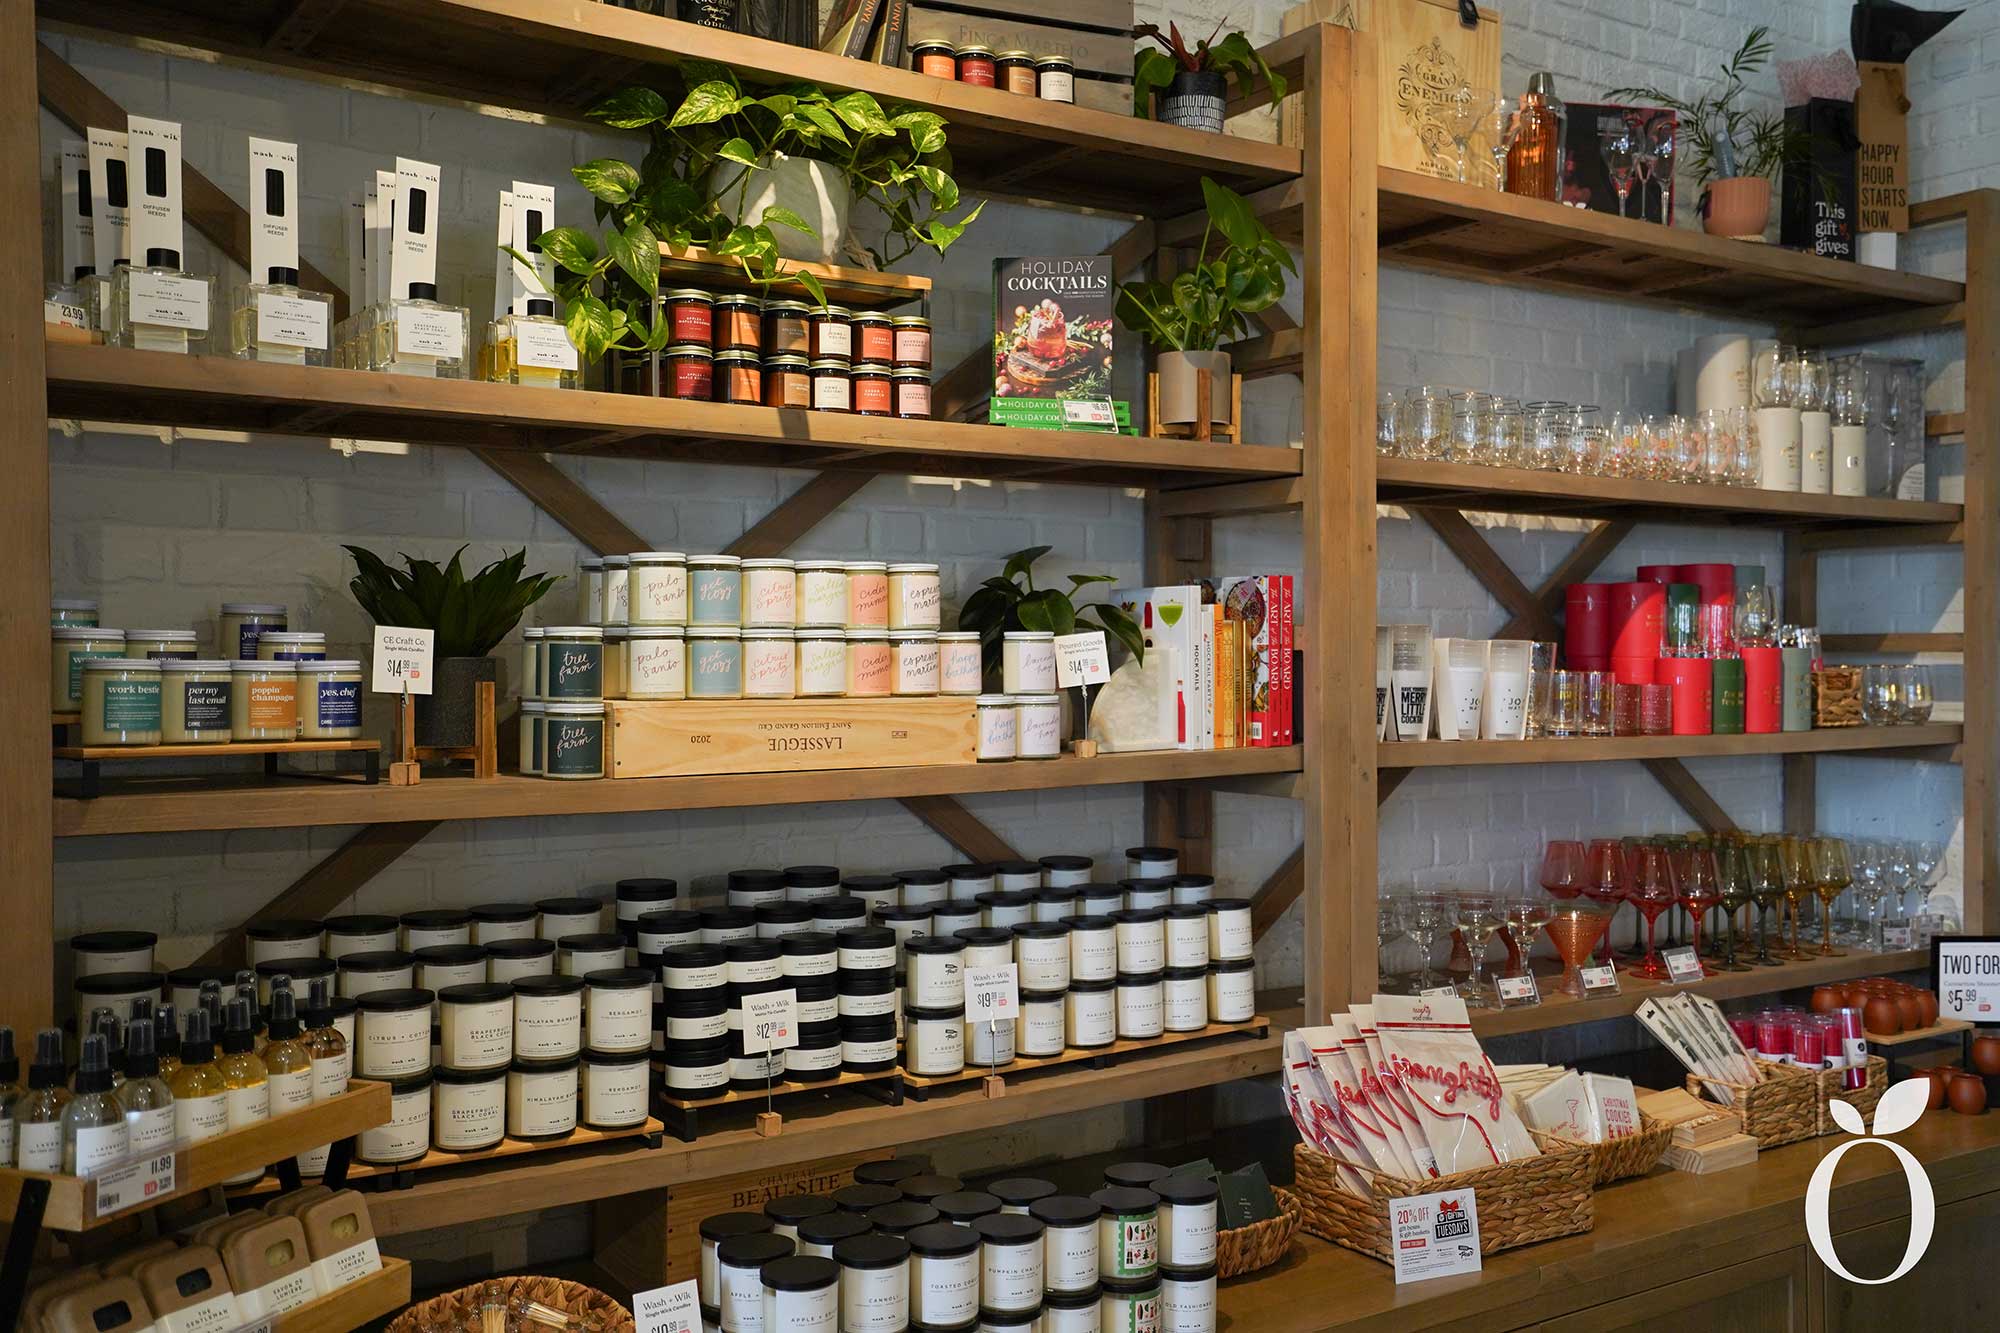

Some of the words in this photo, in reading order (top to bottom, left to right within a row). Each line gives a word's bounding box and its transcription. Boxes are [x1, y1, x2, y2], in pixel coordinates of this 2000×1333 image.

[1422, 71, 1451, 86] GRAN
[1861, 143, 1900, 163] HAPPY
[1861, 165, 1894, 185] HOUR
[1861, 187, 1907, 207] STARTS
[1815, 201, 1846, 219] This
[1815, 219, 1838, 238] gift
[1862, 210, 1893, 229] NOW.
[1815, 237, 1849, 255] gives
[1021, 261, 1095, 275] HOLIDAY
[1007, 274, 1107, 294] COCKTAILS
[1008, 400, 1044, 408] HOLIDAY
[1007, 413, 1043, 421] HOLIDAY
[1270, 601, 1279, 624] ART
[1283, 601, 1291, 624] ART
[383, 636, 394, 644] CE
[395, 636, 414, 645] Craft
[1058, 641, 1082, 650] Poured
[1082, 639, 1104, 647] Goods
[562, 650, 588, 667] tree
[558, 662, 596, 685] farm
[1271, 648, 1279, 691] BOARD
[1283, 648, 1292, 690] BOARD
[108, 685, 136, 694] work
[188, 688, 204, 697] per
[205, 688, 219, 697] my
[188, 695, 205, 705] last
[206, 695, 227, 704] email
[560, 724, 586, 742] tree
[757, 722, 774, 731] CRU
[775, 722, 800, 731] GRAND
[835, 721, 852, 730] SAINT
[556, 735, 595, 758] farm
[690, 735, 712, 744] 2020
[1942, 955, 1972, 975] TWO
[1975, 955, 2000, 975] FOR
[751, 1003, 770, 1012] Wash
[775, 999, 790, 1007] Wik
[1605, 1109, 1632, 1125] COOKIES
[151, 1155, 172, 1175] 11.99
[731, 1173, 841, 1210] BEAU-SITE
[1397, 1208, 1418, 1225] 20%
[1418, 1206, 1430, 1221] OFF
[1436, 1220, 1469, 1238] TUESDAYS
[643, 1298, 667, 1311] Wash
[674, 1291, 691, 1303] Wik
